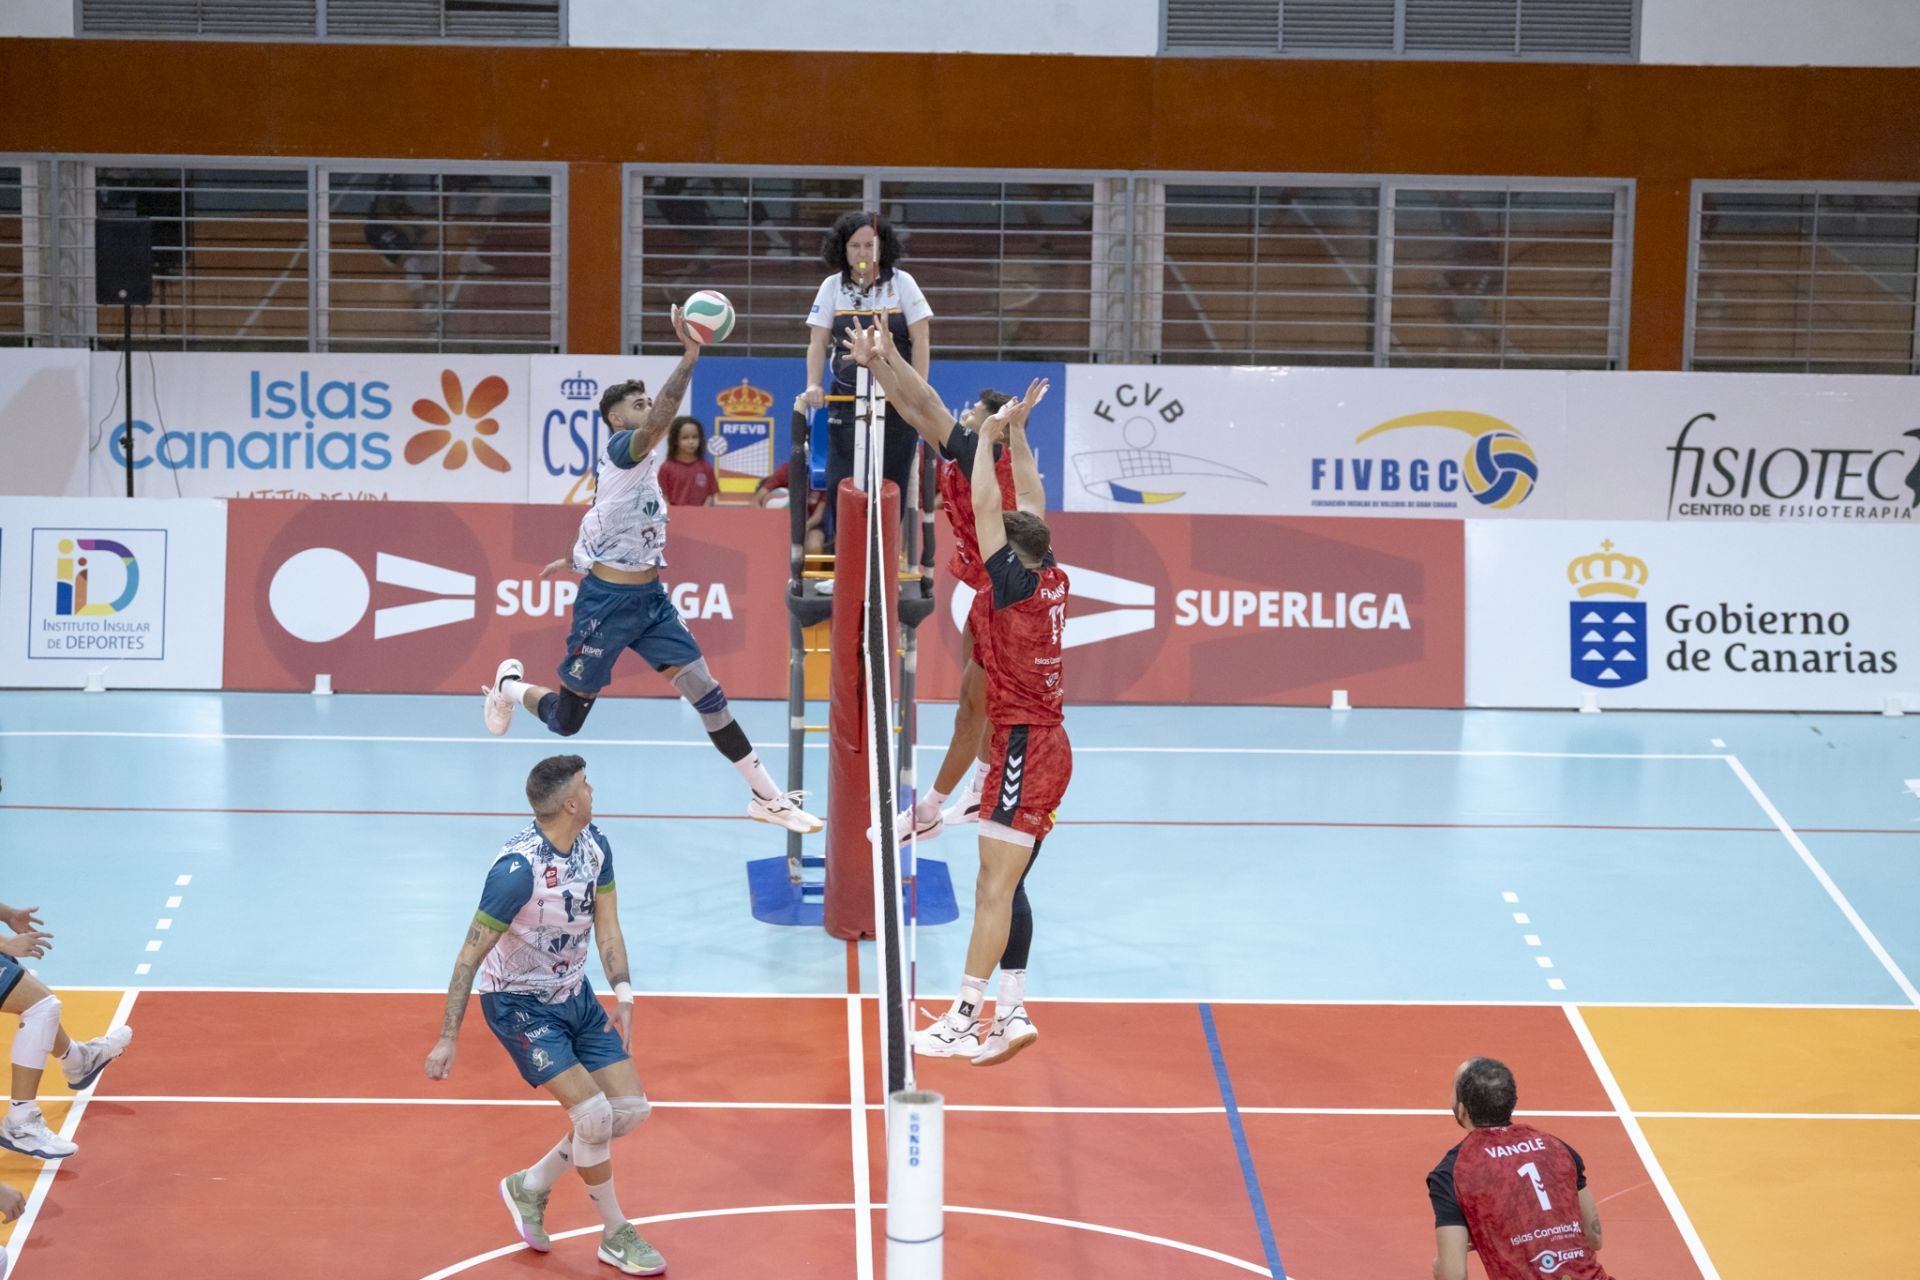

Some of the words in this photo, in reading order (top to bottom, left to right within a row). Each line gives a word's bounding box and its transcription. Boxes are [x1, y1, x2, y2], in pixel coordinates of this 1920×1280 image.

[251, 371, 392, 420] Islas
[1093, 382, 1185, 423] FCVB
[109, 420, 392, 470] Canarias
[723, 424, 766, 434] RFEVB
[1311, 458, 1458, 492] FIVBGC
[1679, 503, 1744, 516] CENTRO
[1750, 504, 1771, 517] DE
[1779, 505, 1912, 519] FISIOTERAPIA
[43, 618, 99, 631] INSTITUTO
[104, 618, 150, 632] INSULAR
[1175, 589, 1411, 630] SUPERLIGA
[1666, 602, 1850, 635] Gobierno
[47, 639, 62, 649] DE
[66, 635, 144, 649] DEPORTES
[1666, 640, 1711, 671] de
[1725, 641, 1898, 674] Canarias
[1485, 1138, 1546, 1159] VANOLE
[1517, 1162, 1552, 1211] 1
[1510, 1232, 1533, 1246] Islas
[1557, 1249, 1584, 1261] Icare
